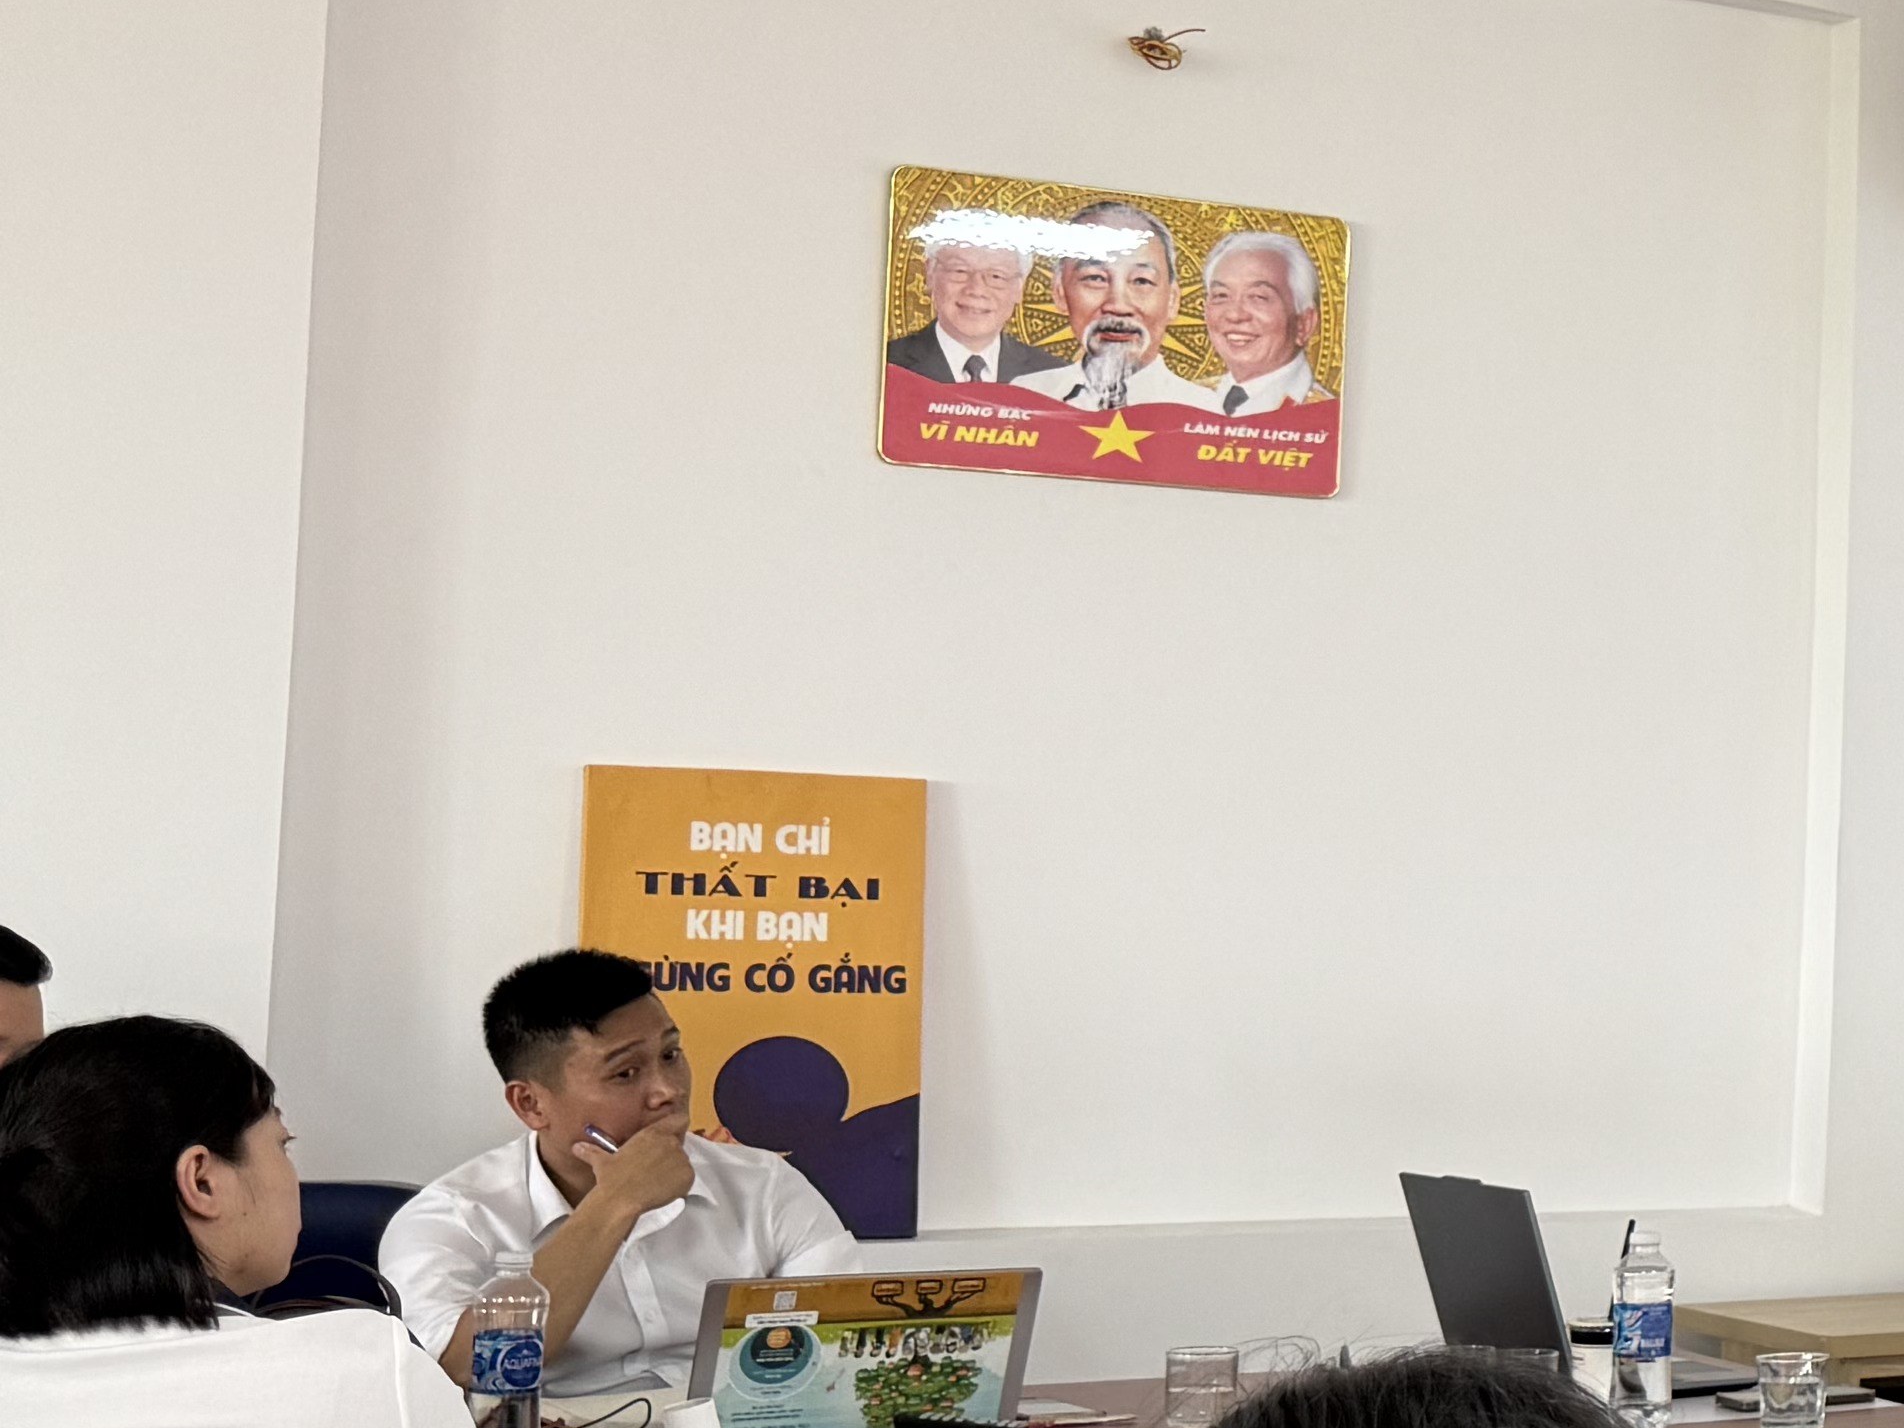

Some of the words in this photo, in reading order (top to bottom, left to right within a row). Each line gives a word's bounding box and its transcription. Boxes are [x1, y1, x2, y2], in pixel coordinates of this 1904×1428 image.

[920, 420, 951, 441] VĨ
[953, 425, 1039, 448] NHÂN
[1262, 428, 1301, 443] LỊCH
[1196, 439, 1252, 464] ĐẤT
[1257, 447, 1314, 472] VIỆT
[690, 820, 763, 860] BẠN
[775, 816, 831, 856] CHỈ
[635, 861, 777, 898] THẤT
[798, 875, 880, 908] BẠI
[686, 908, 745, 941] KHI
[756, 910, 829, 949] BẠN
[744, 952, 796, 993] CỐ
[808, 952, 907, 994] GẮNG
